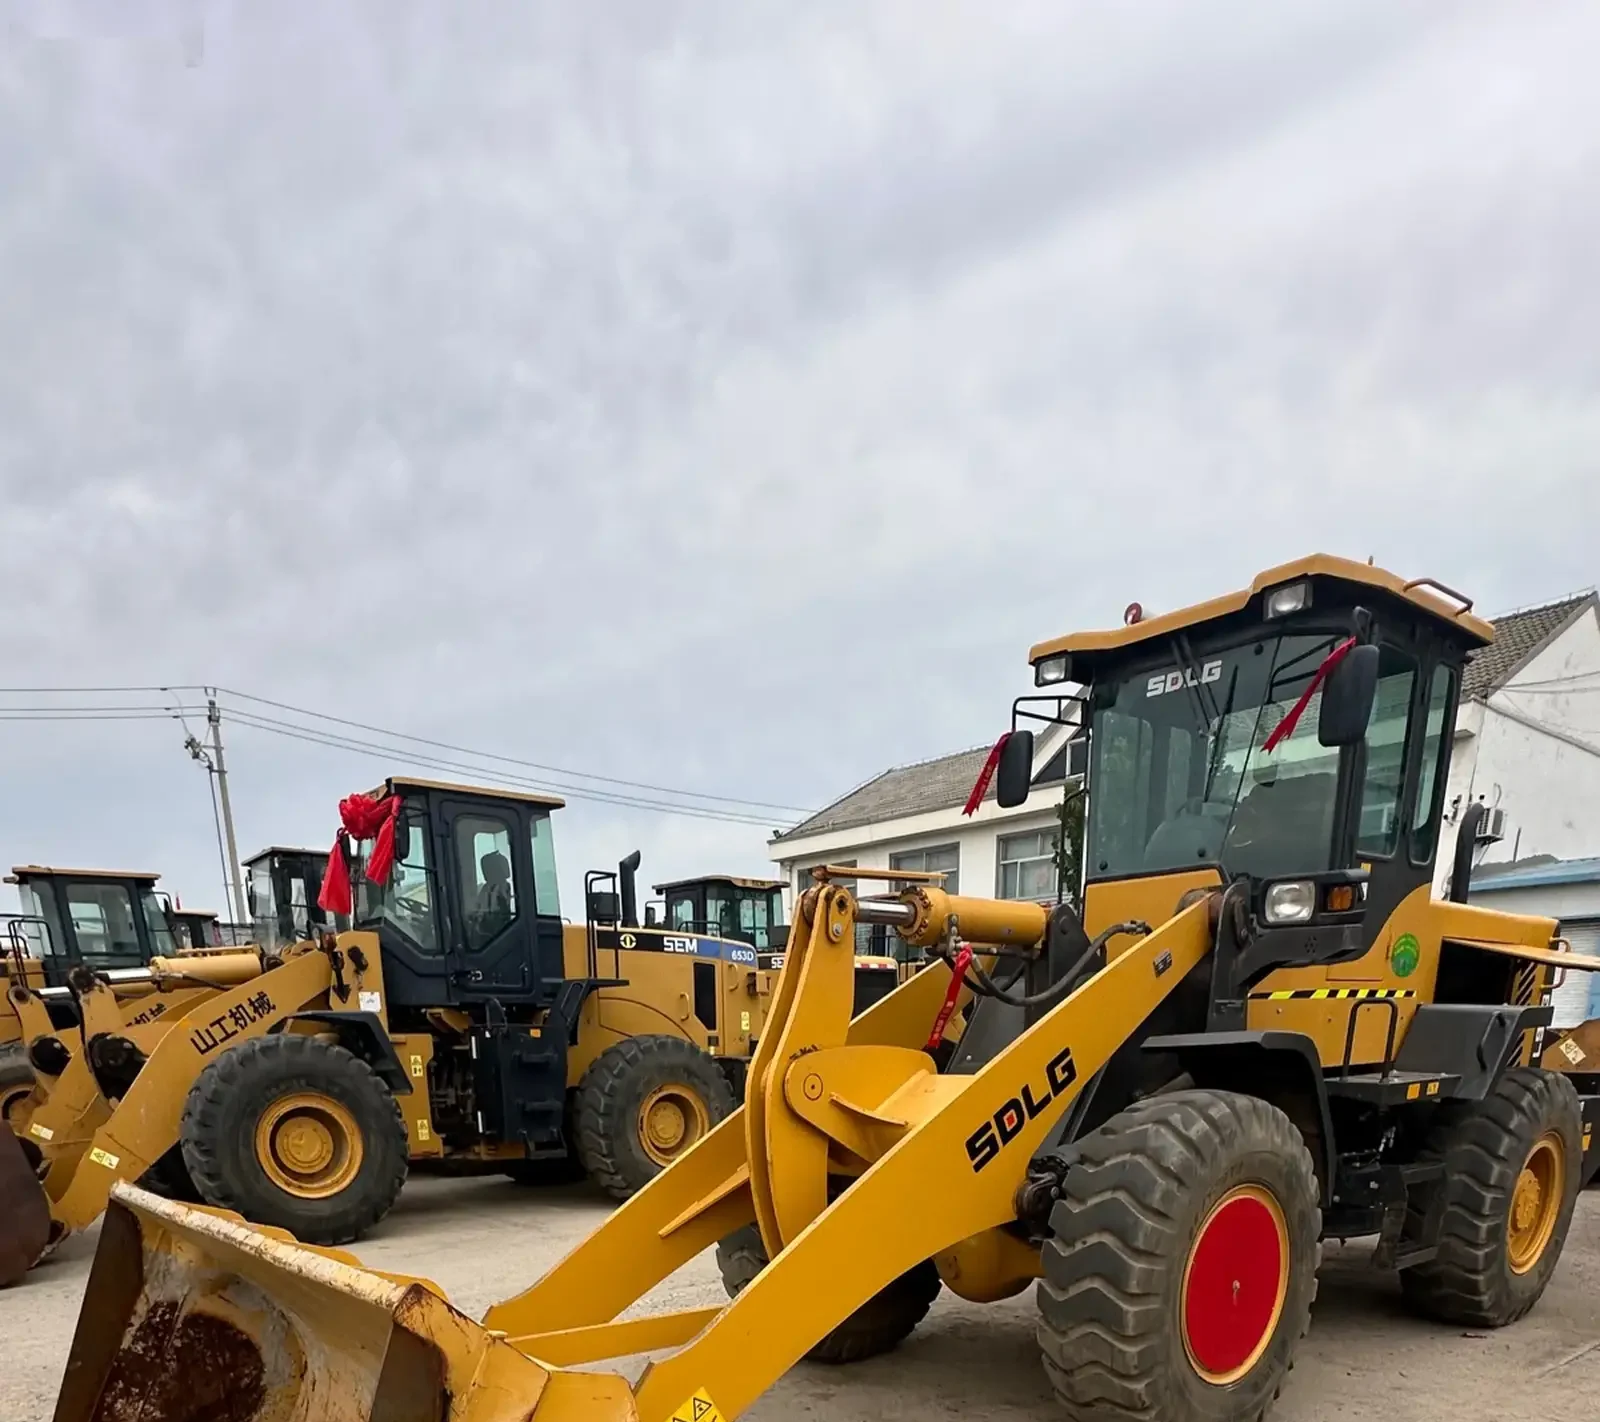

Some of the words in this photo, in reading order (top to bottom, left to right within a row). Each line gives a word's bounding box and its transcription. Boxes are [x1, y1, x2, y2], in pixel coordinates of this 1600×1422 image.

[1146, 660, 1222, 697] SDLG
[663, 936, 697, 953] SEM
[731, 949, 754, 962] 653D
[771, 957, 785, 969] SE
[190, 991, 277, 1055] 山工机械
[964, 1046, 1077, 1173] SDLG
